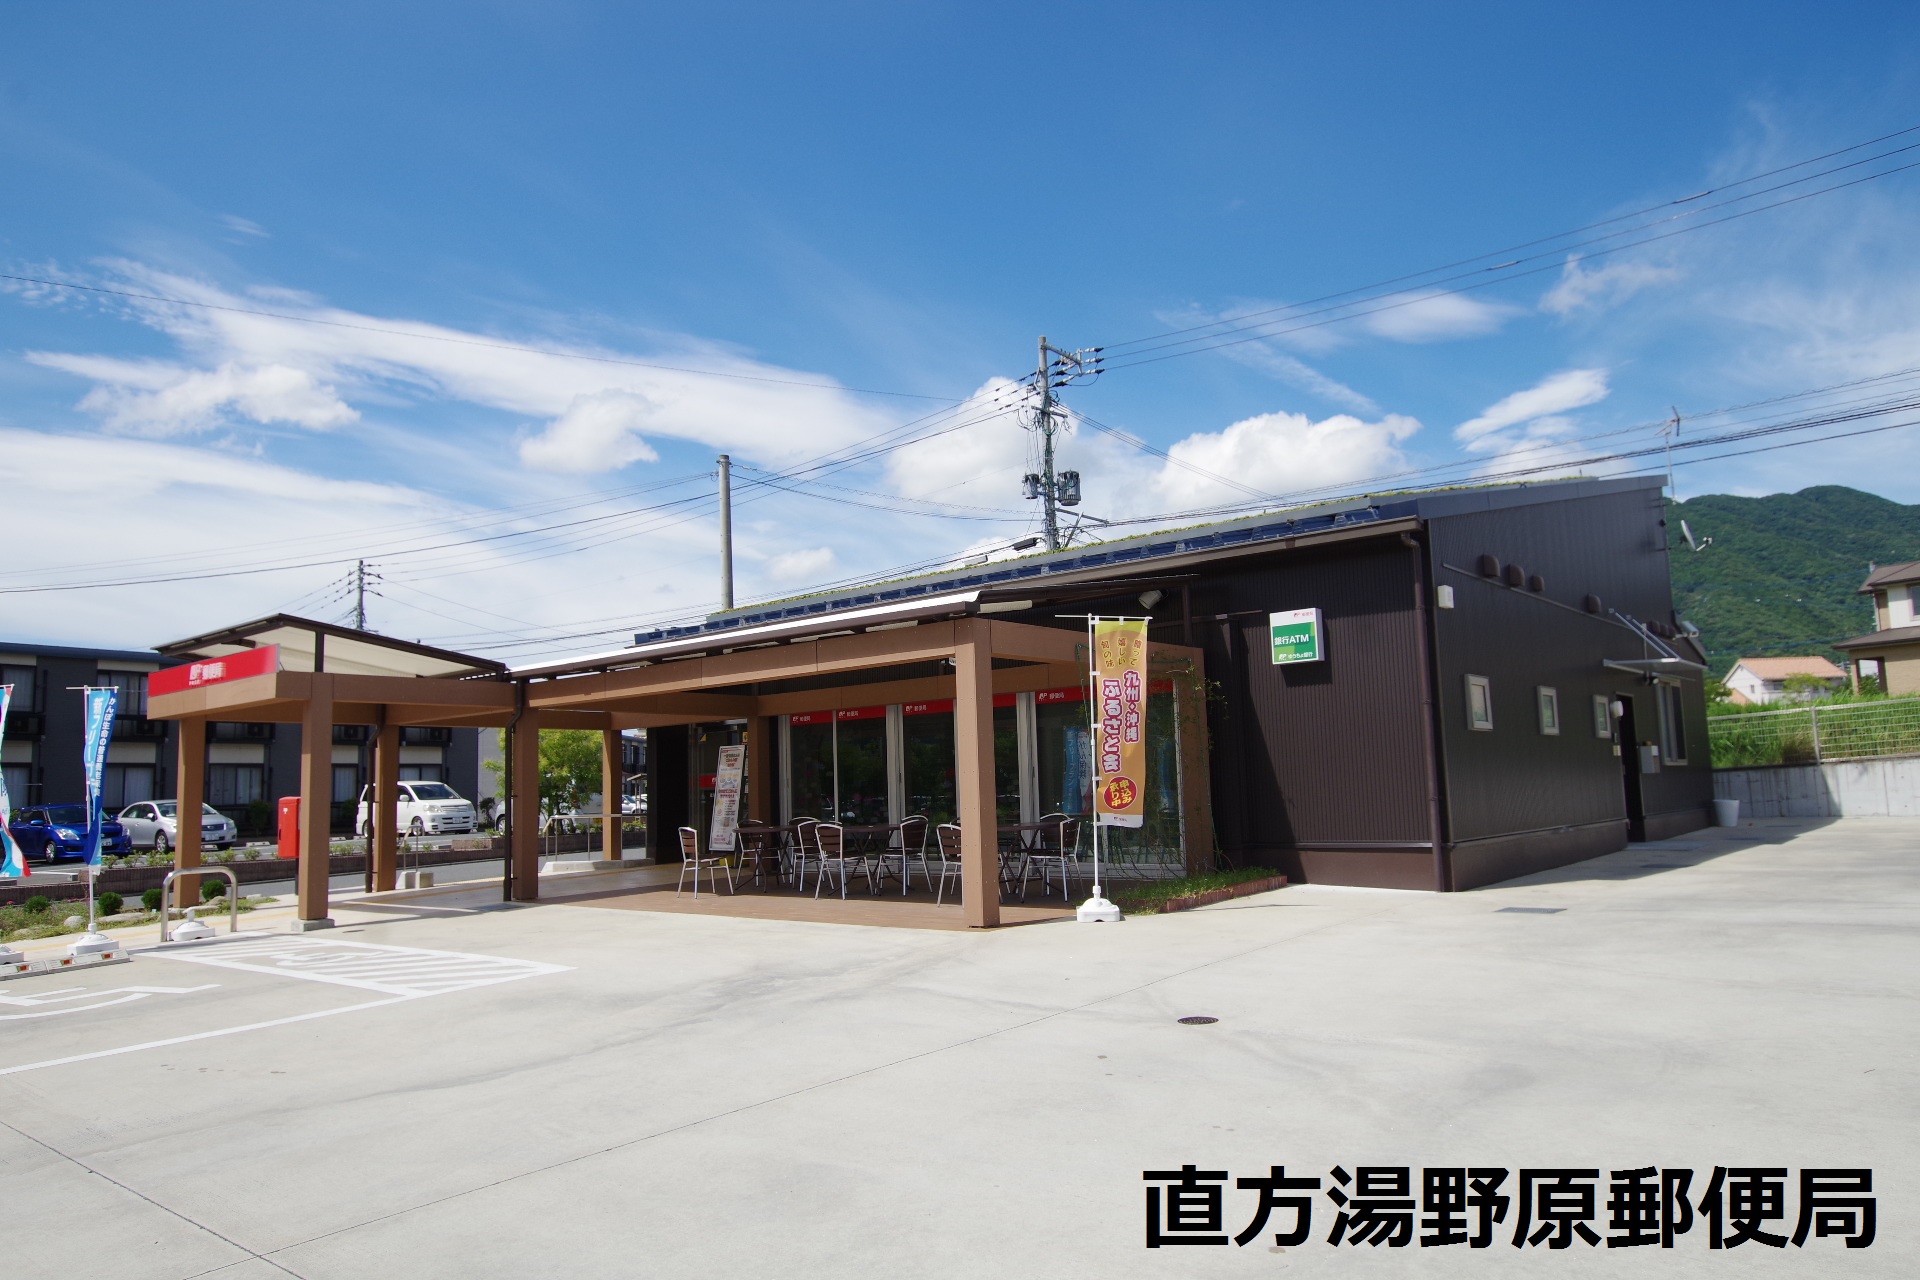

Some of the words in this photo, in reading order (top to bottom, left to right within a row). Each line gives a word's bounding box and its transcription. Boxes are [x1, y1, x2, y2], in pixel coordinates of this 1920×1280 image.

[1274, 634, 1309, 646] 銀行ATM
[1103, 680, 1122, 772] ふるさと会
[1110, 782, 1120, 807] 承り中
[1120, 780, 1132, 804] 申込み
